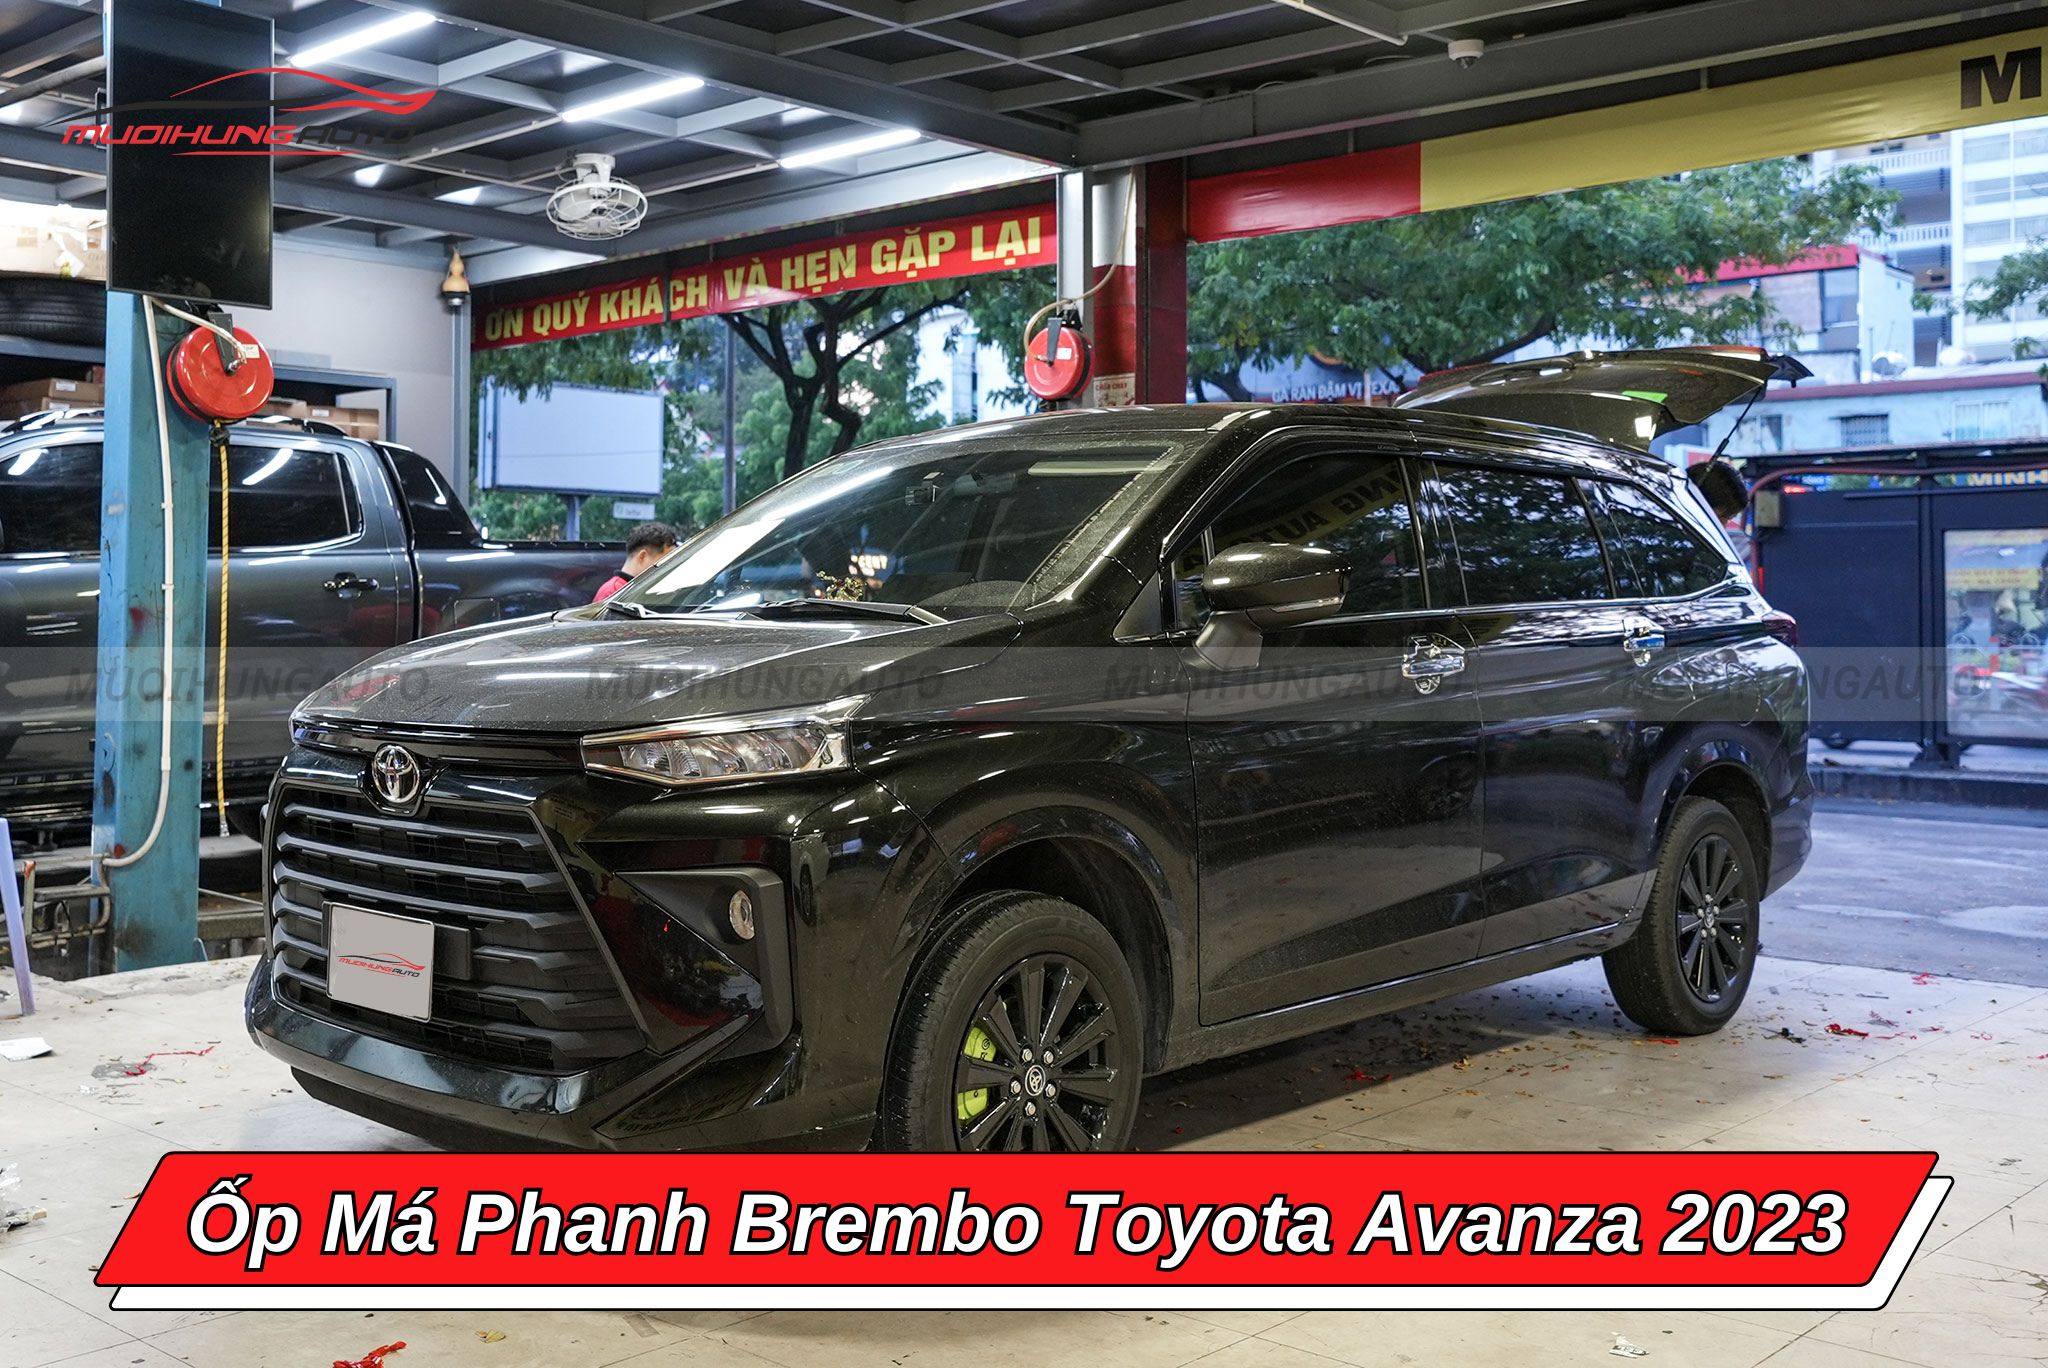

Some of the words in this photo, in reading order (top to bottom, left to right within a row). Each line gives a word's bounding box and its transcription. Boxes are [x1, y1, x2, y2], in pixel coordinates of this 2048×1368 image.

[1961, 47, 2042, 110] M
[533, 290, 590, 336] QUÝ
[600, 273, 708, 324] KHÁCH
[724, 257, 768, 300] VÀ
[781, 244, 857, 293] HẸN
[871, 228, 956, 278] GẶP
[971, 217, 1041, 265] LẠI
